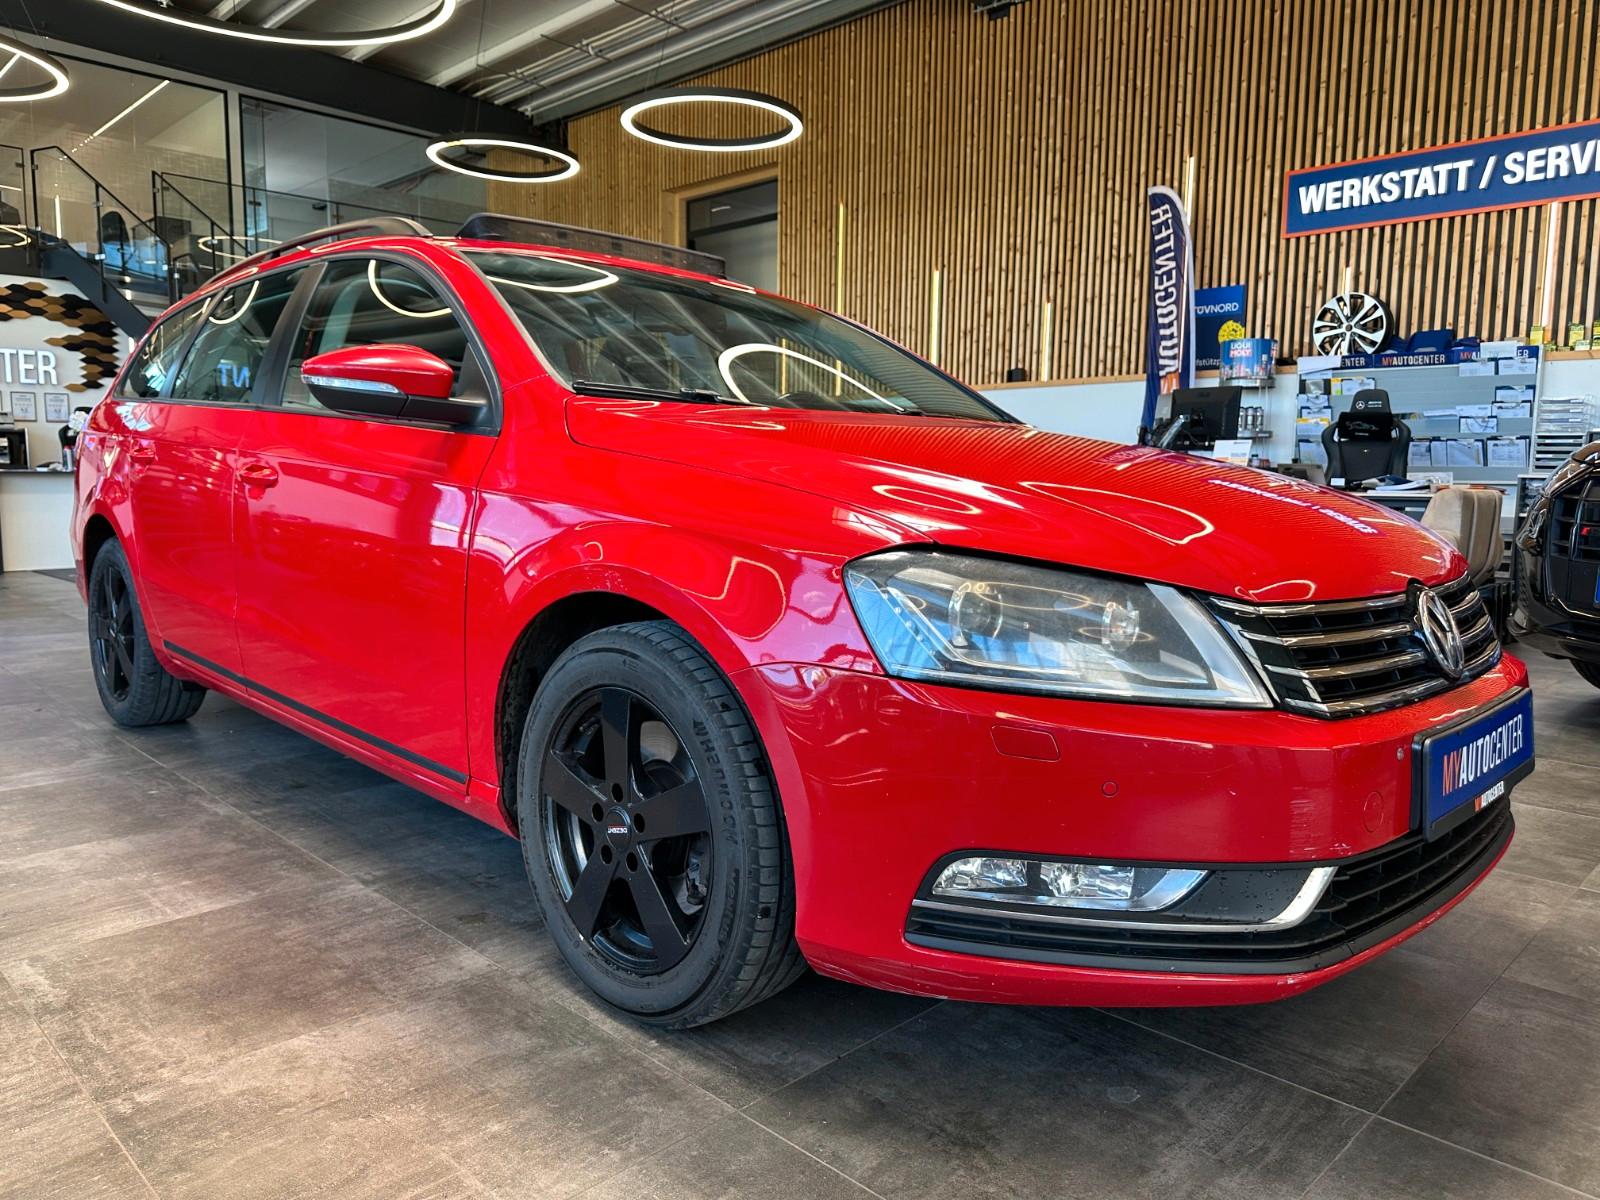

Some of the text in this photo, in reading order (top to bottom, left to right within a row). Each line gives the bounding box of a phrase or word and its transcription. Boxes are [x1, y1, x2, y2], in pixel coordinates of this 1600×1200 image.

[1299, 160, 1474, 214] WERKSTATT
[1479, 156, 1496, 189] /
[0, 348, 57, 385] TER
[1382, 354, 1445, 366] MYAUTOCENTER
[1443, 714, 1522, 797] MYAUTOCENTER
